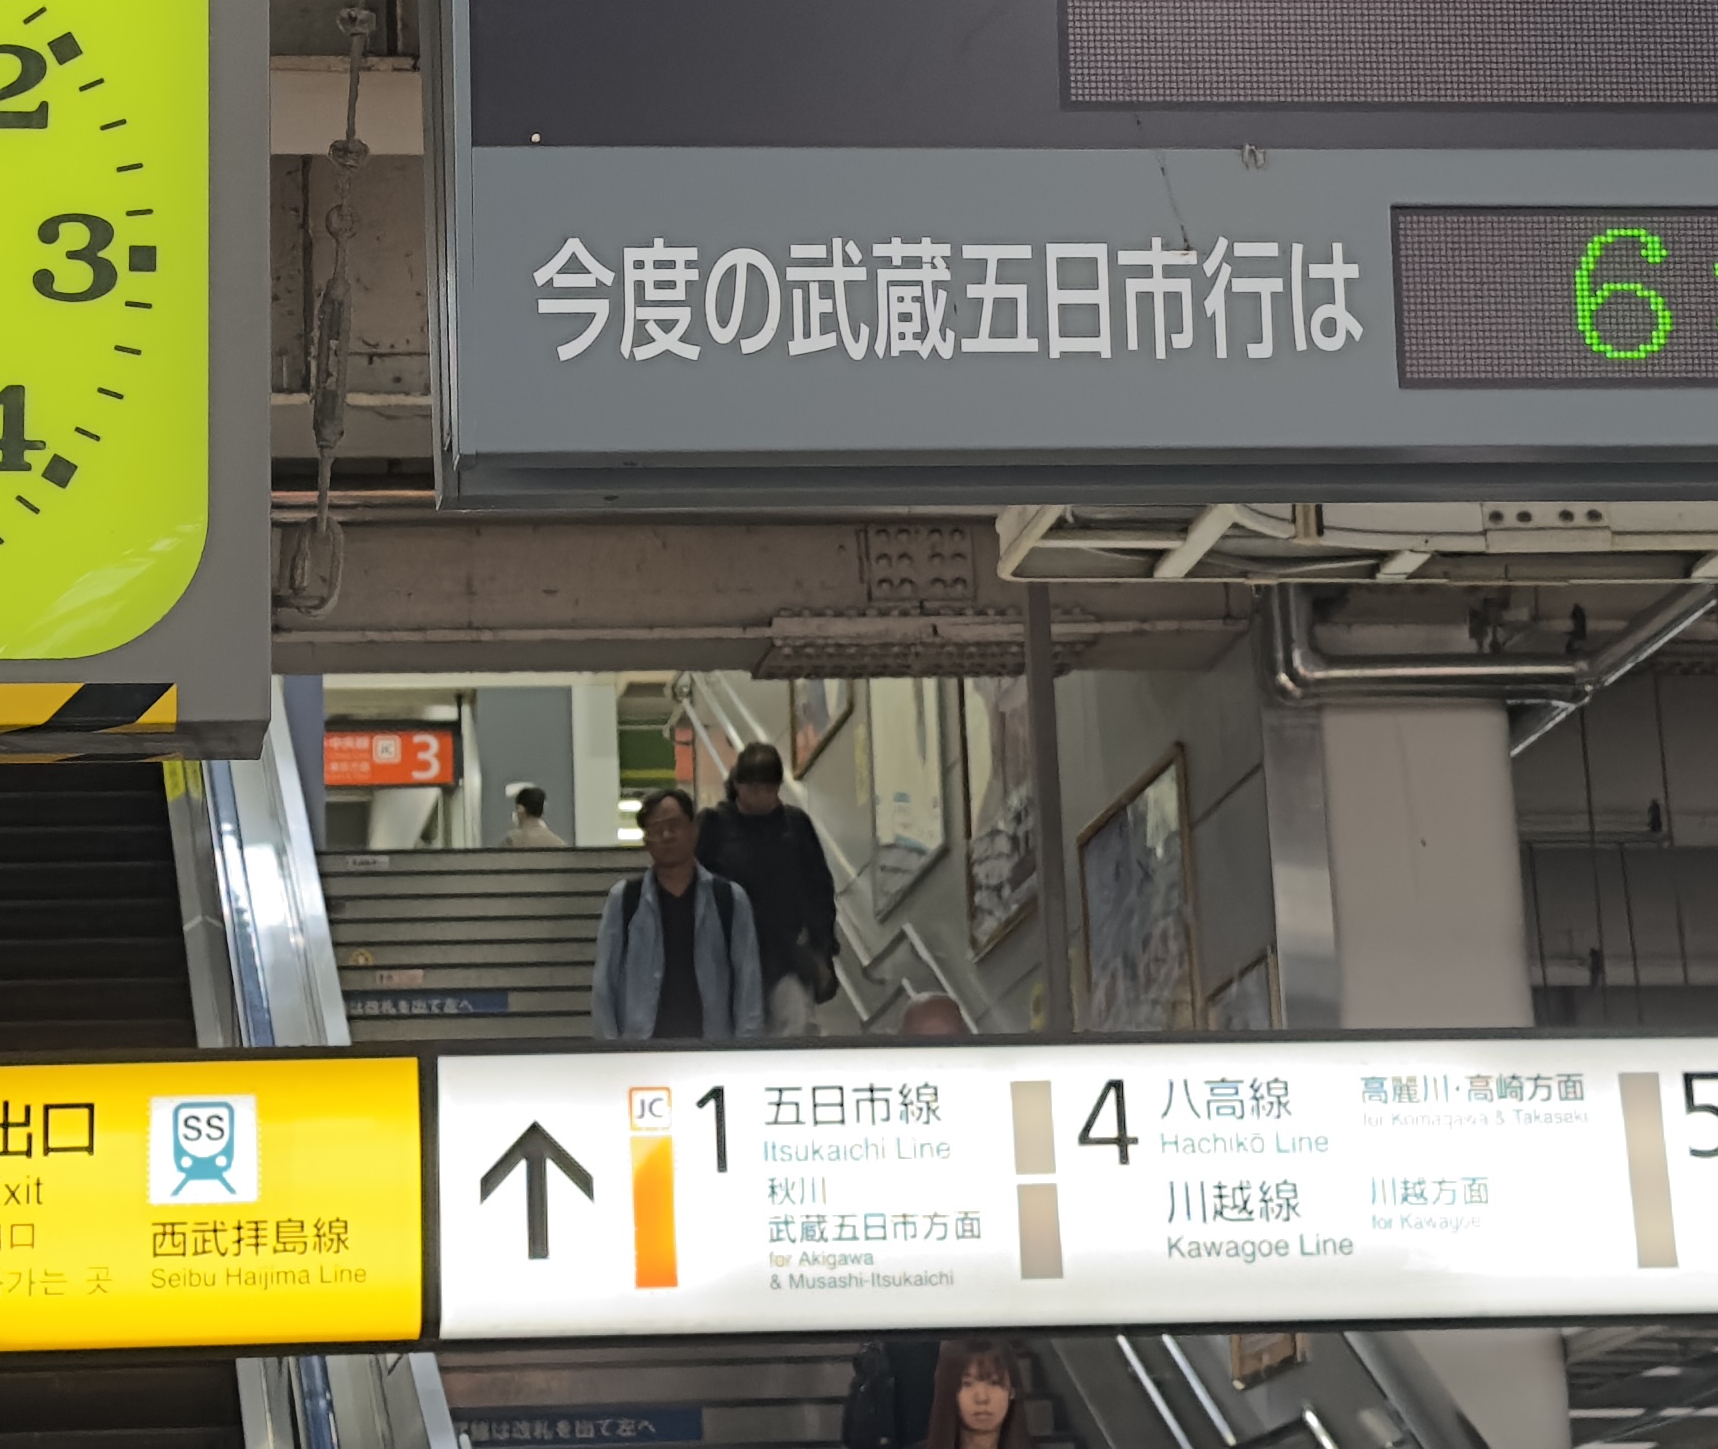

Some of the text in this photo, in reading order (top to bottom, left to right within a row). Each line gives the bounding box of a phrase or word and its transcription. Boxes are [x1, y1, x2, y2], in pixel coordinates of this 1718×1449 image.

[31, 212, 120, 303] 3
[532, 235, 1365, 361] 今度の武蔵五日市行は
[410, 733, 442, 781] 3
[635, 1096, 665, 1120] JC
[764, 1081, 942, 1127] 五日市線
[1161, 1077, 1292, 1120] 八高線
[181, 1113, 226, 1143] SS
[695, 1084, 729, 1173] 1
[1078, 1078, 1139, 1165] 4
[763, 1136, 951, 1162] Itsukaichi Line
[1275, 1131, 1330, 1154] Line
[768, 1176, 827, 1206] 秋川
[1168, 1179, 1301, 1224] 川越線
[1371, 1176, 1489, 1206] 川越方面
[150, 1216, 350, 1259] 西武拝島線
[768, 1210, 982, 1244] 武蔵五日市方面
[769, 1251, 875, 1270] for Akigawa
[1166, 1233, 1355, 1264] Kawagoe Line
[86, 1265, 113, 1295] 곳
[150, 1264, 367, 1292] Seibu Haijima Line
[769, 1269, 955, 1291] & Musashi-Itsukaichi
